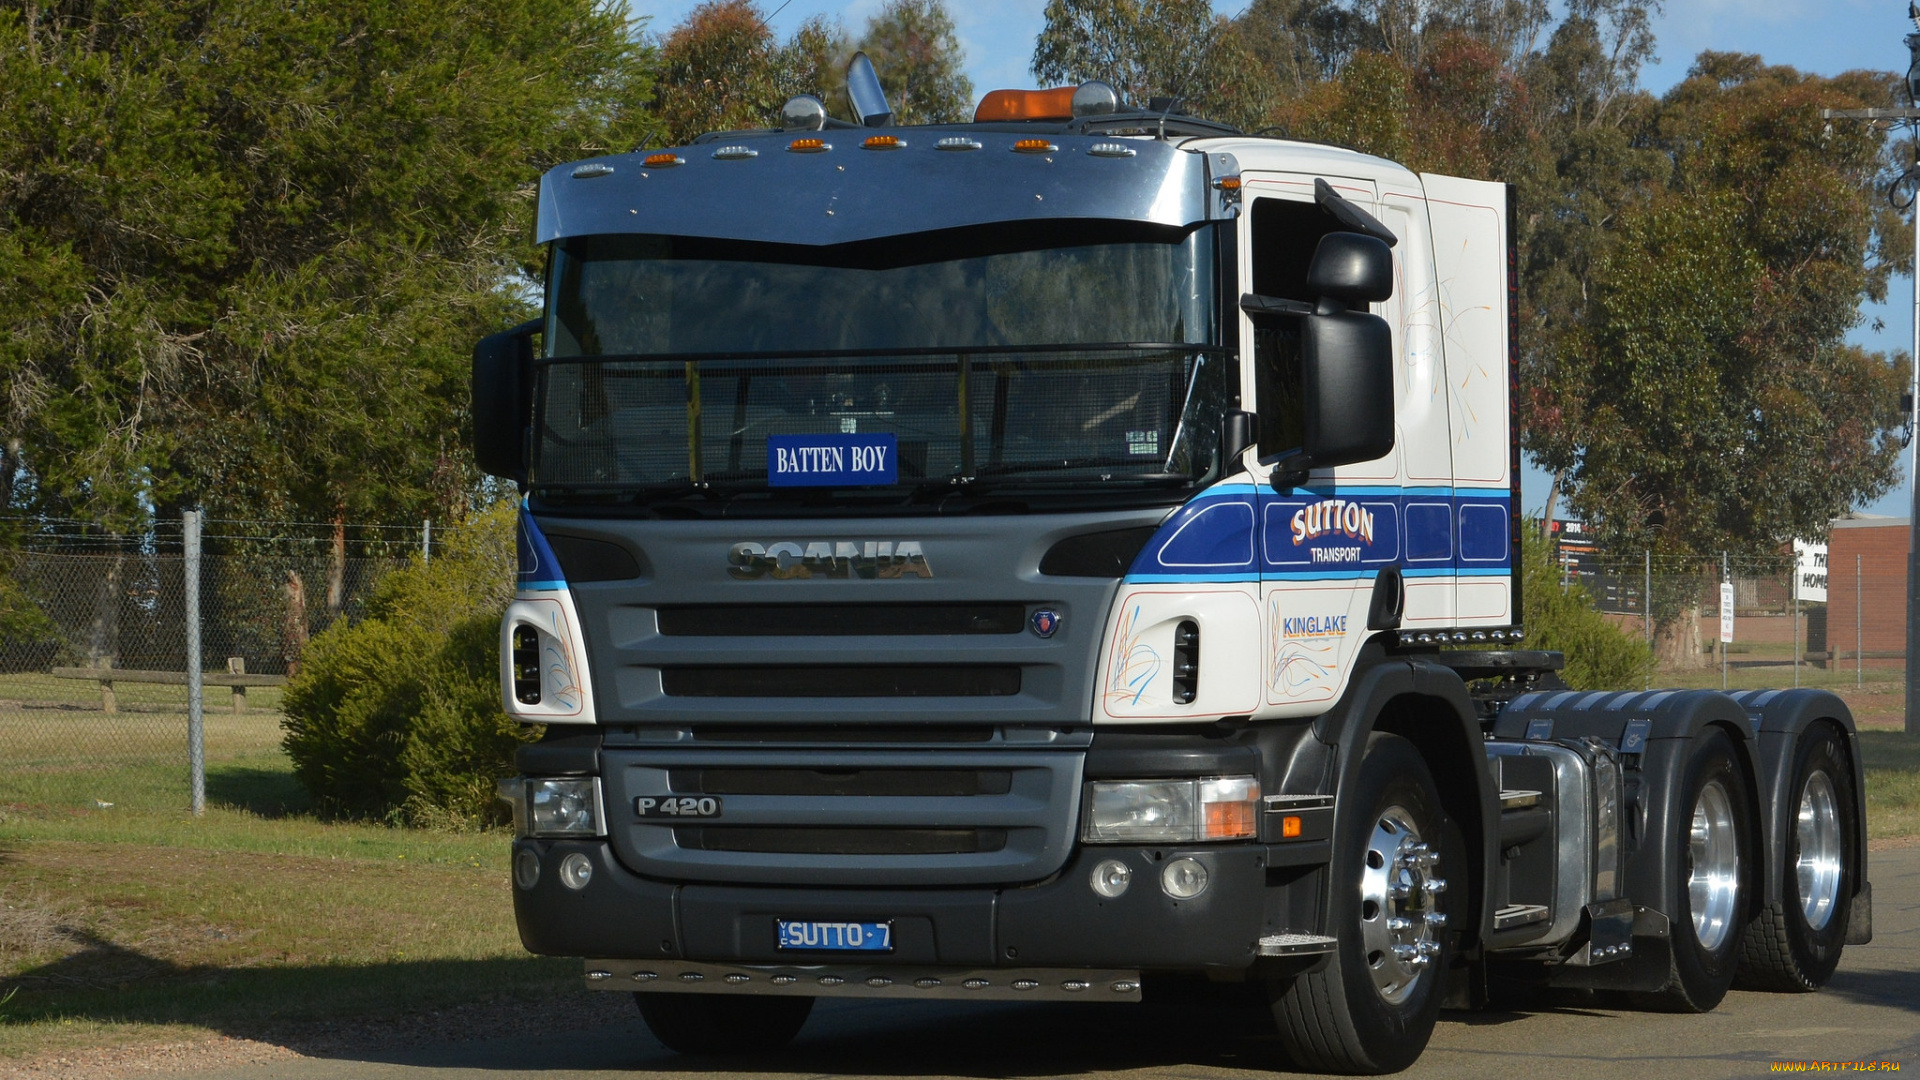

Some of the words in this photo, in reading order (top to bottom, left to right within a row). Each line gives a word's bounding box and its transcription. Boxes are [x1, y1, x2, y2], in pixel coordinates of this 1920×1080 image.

[776, 446, 843, 473] BATTEN
[851, 445, 887, 472] BOY
[1291, 499, 1374, 546] SUTTON
[727, 541, 933, 580] SCANIA
[1311, 547, 1361, 563] TRANSPORT
[1814, 552, 1827, 568] TH
[1283, 615, 1347, 637] KINGLAKE
[638, 797, 656, 815] P
[660, 797, 716, 815] 420
[780, 922, 788, 945] VIC
